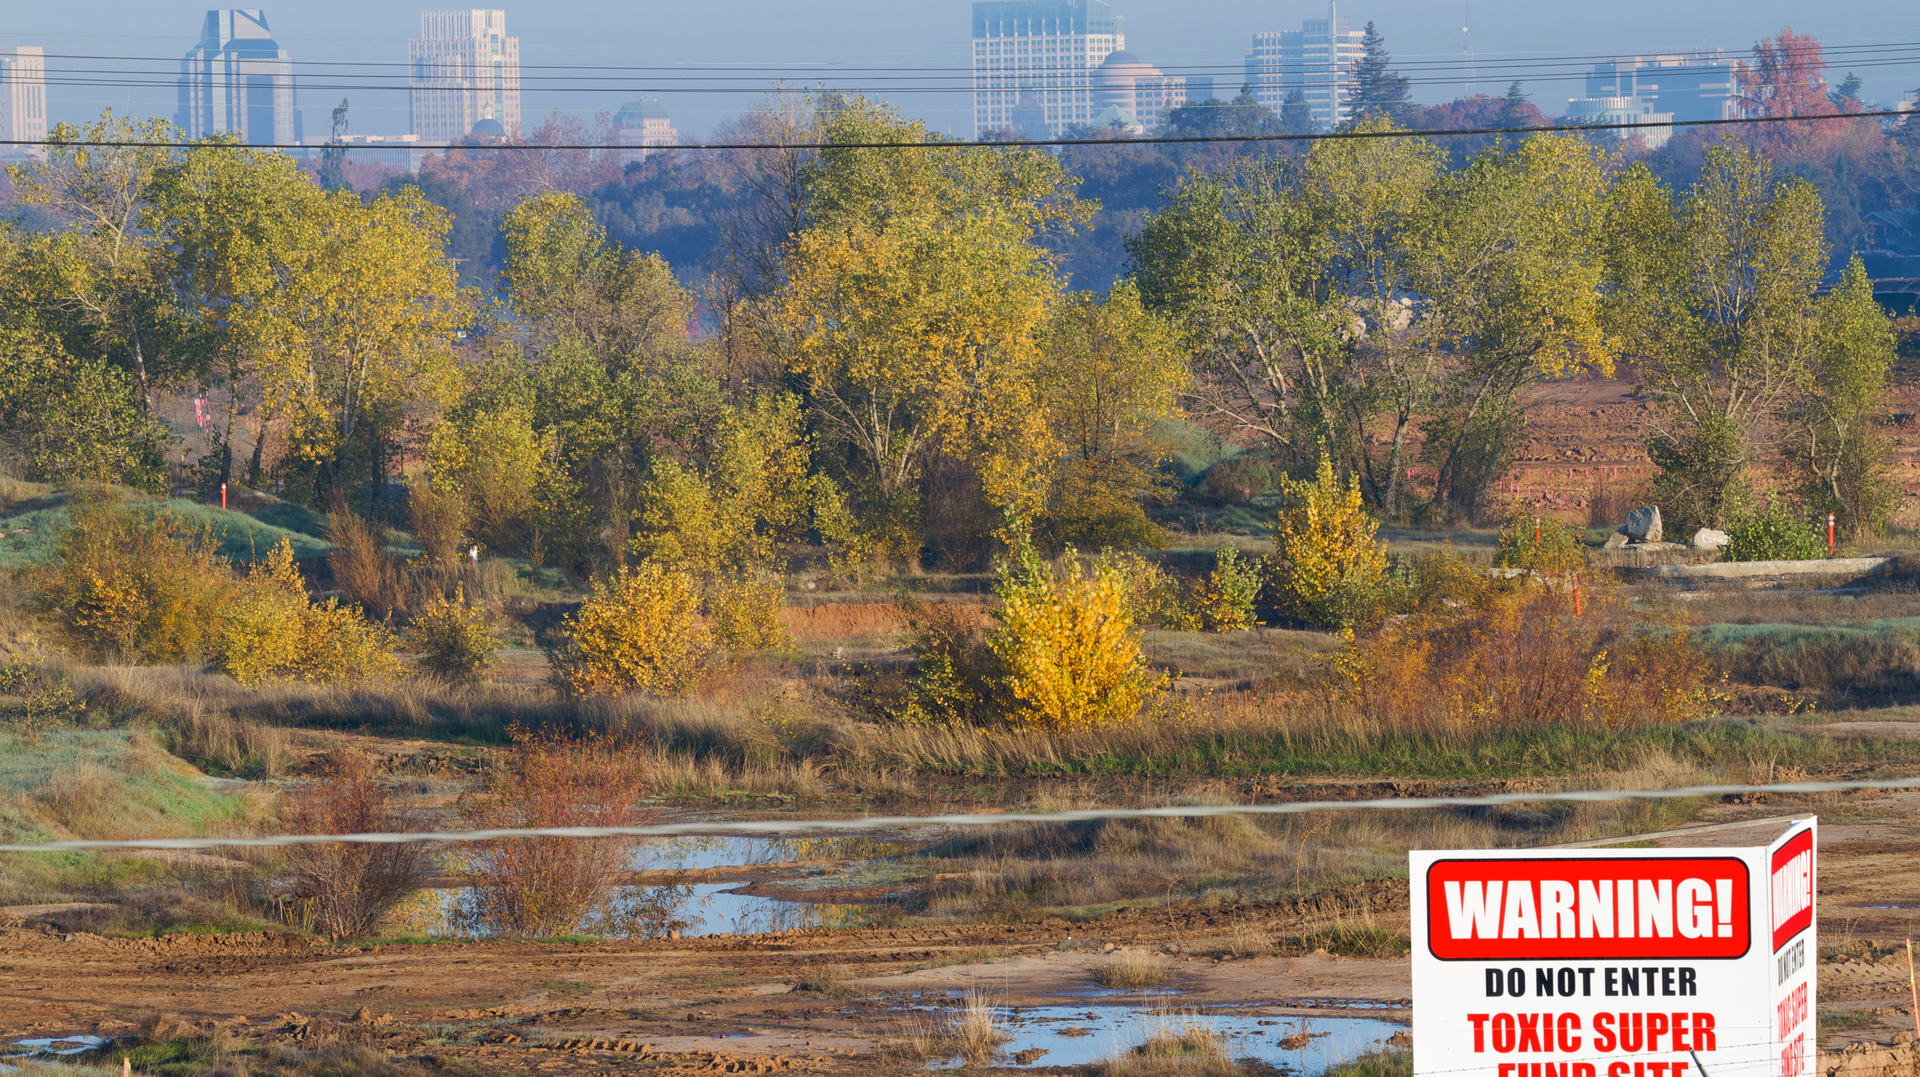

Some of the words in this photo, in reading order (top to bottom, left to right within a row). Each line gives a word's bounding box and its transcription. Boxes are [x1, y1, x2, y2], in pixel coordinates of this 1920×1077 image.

[1444, 878, 1733, 939] WARNING!
[1772, 849, 1811, 932] WARNING!
[1792, 938, 1805, 974] ENTER
[1485, 968, 1526, 997] DO
[1536, 968, 1595, 997] NOT
[1605, 967, 1697, 997] ENTER
[1792, 981, 1808, 1030] SUPER
[1467, 1012, 1582, 1053] TOXIC
[1593, 1012, 1717, 1053] SUPER
